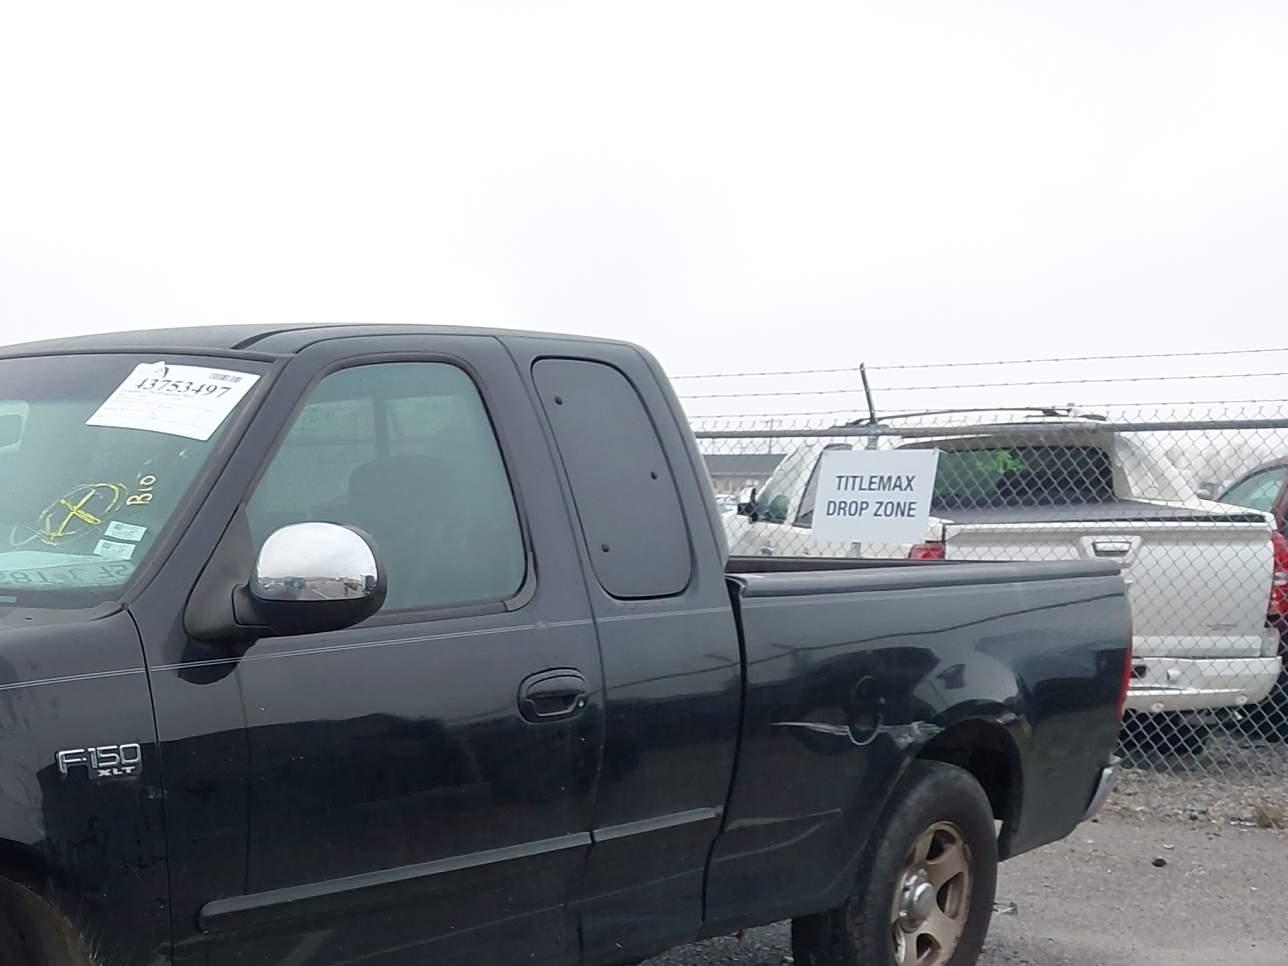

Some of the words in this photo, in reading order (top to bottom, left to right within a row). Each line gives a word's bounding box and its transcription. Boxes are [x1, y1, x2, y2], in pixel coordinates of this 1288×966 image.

[836, 475, 916, 491] TITLEMAX
[826, 500, 869, 516] DROP
[873, 501, 917, 517] ZONE
[97, 766, 136, 777] XLT
